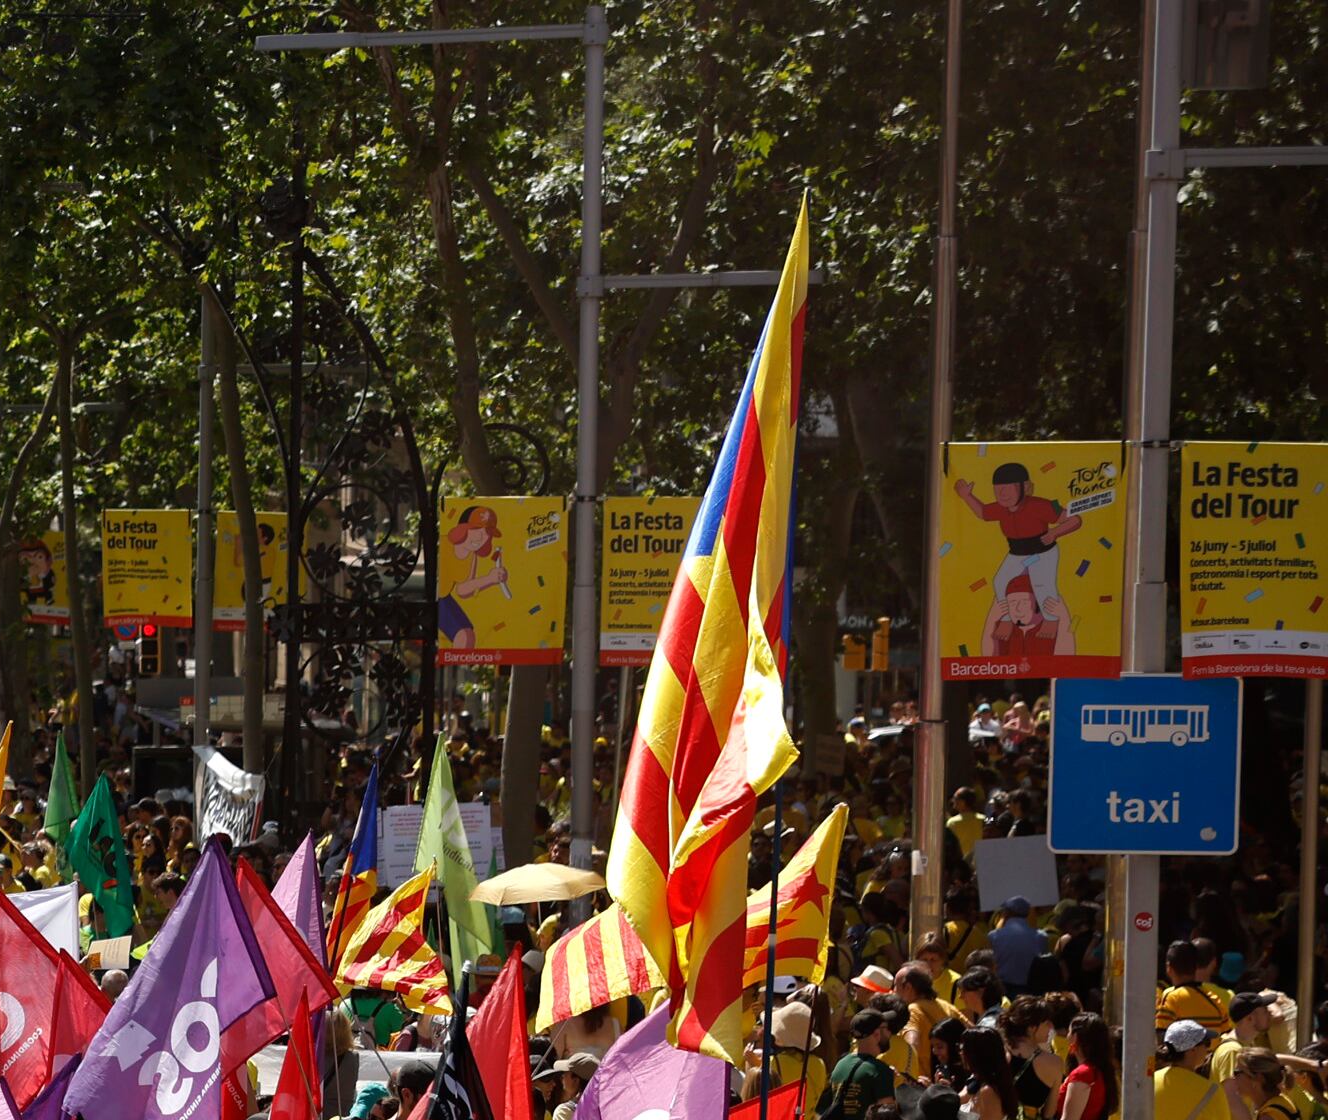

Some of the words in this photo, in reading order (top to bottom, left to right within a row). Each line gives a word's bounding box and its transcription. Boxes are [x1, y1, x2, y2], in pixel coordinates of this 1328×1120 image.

[1192, 461, 1221, 487] La
[1227, 462, 1298, 487] Festa
[1191, 493, 1232, 519] del
[1238, 494, 1299, 519] Tour
[107, 521, 121, 533] La
[124, 521, 157, 534] Festa
[610, 512, 630, 530] La
[635, 512, 683, 530] Festa
[107, 536, 126, 549] del
[129, 537, 158, 550] Tour
[610, 534, 638, 553] del
[643, 535, 685, 553] Tour
[1190, 541, 1201, 552] 26
[1202, 541, 1228, 555] juny
[1239, 541, 1245, 551] 5
[1246, 540, 1277, 554] juliol
[1250, 571, 1280, 580] esport
[1281, 572, 1297, 580] per
[444, 652, 493, 662] Barcelona
[951, 662, 1017, 676] Barcelona
[1216, 664, 1259, 674] Barcelona
[1106, 792, 1181, 824] taxi
